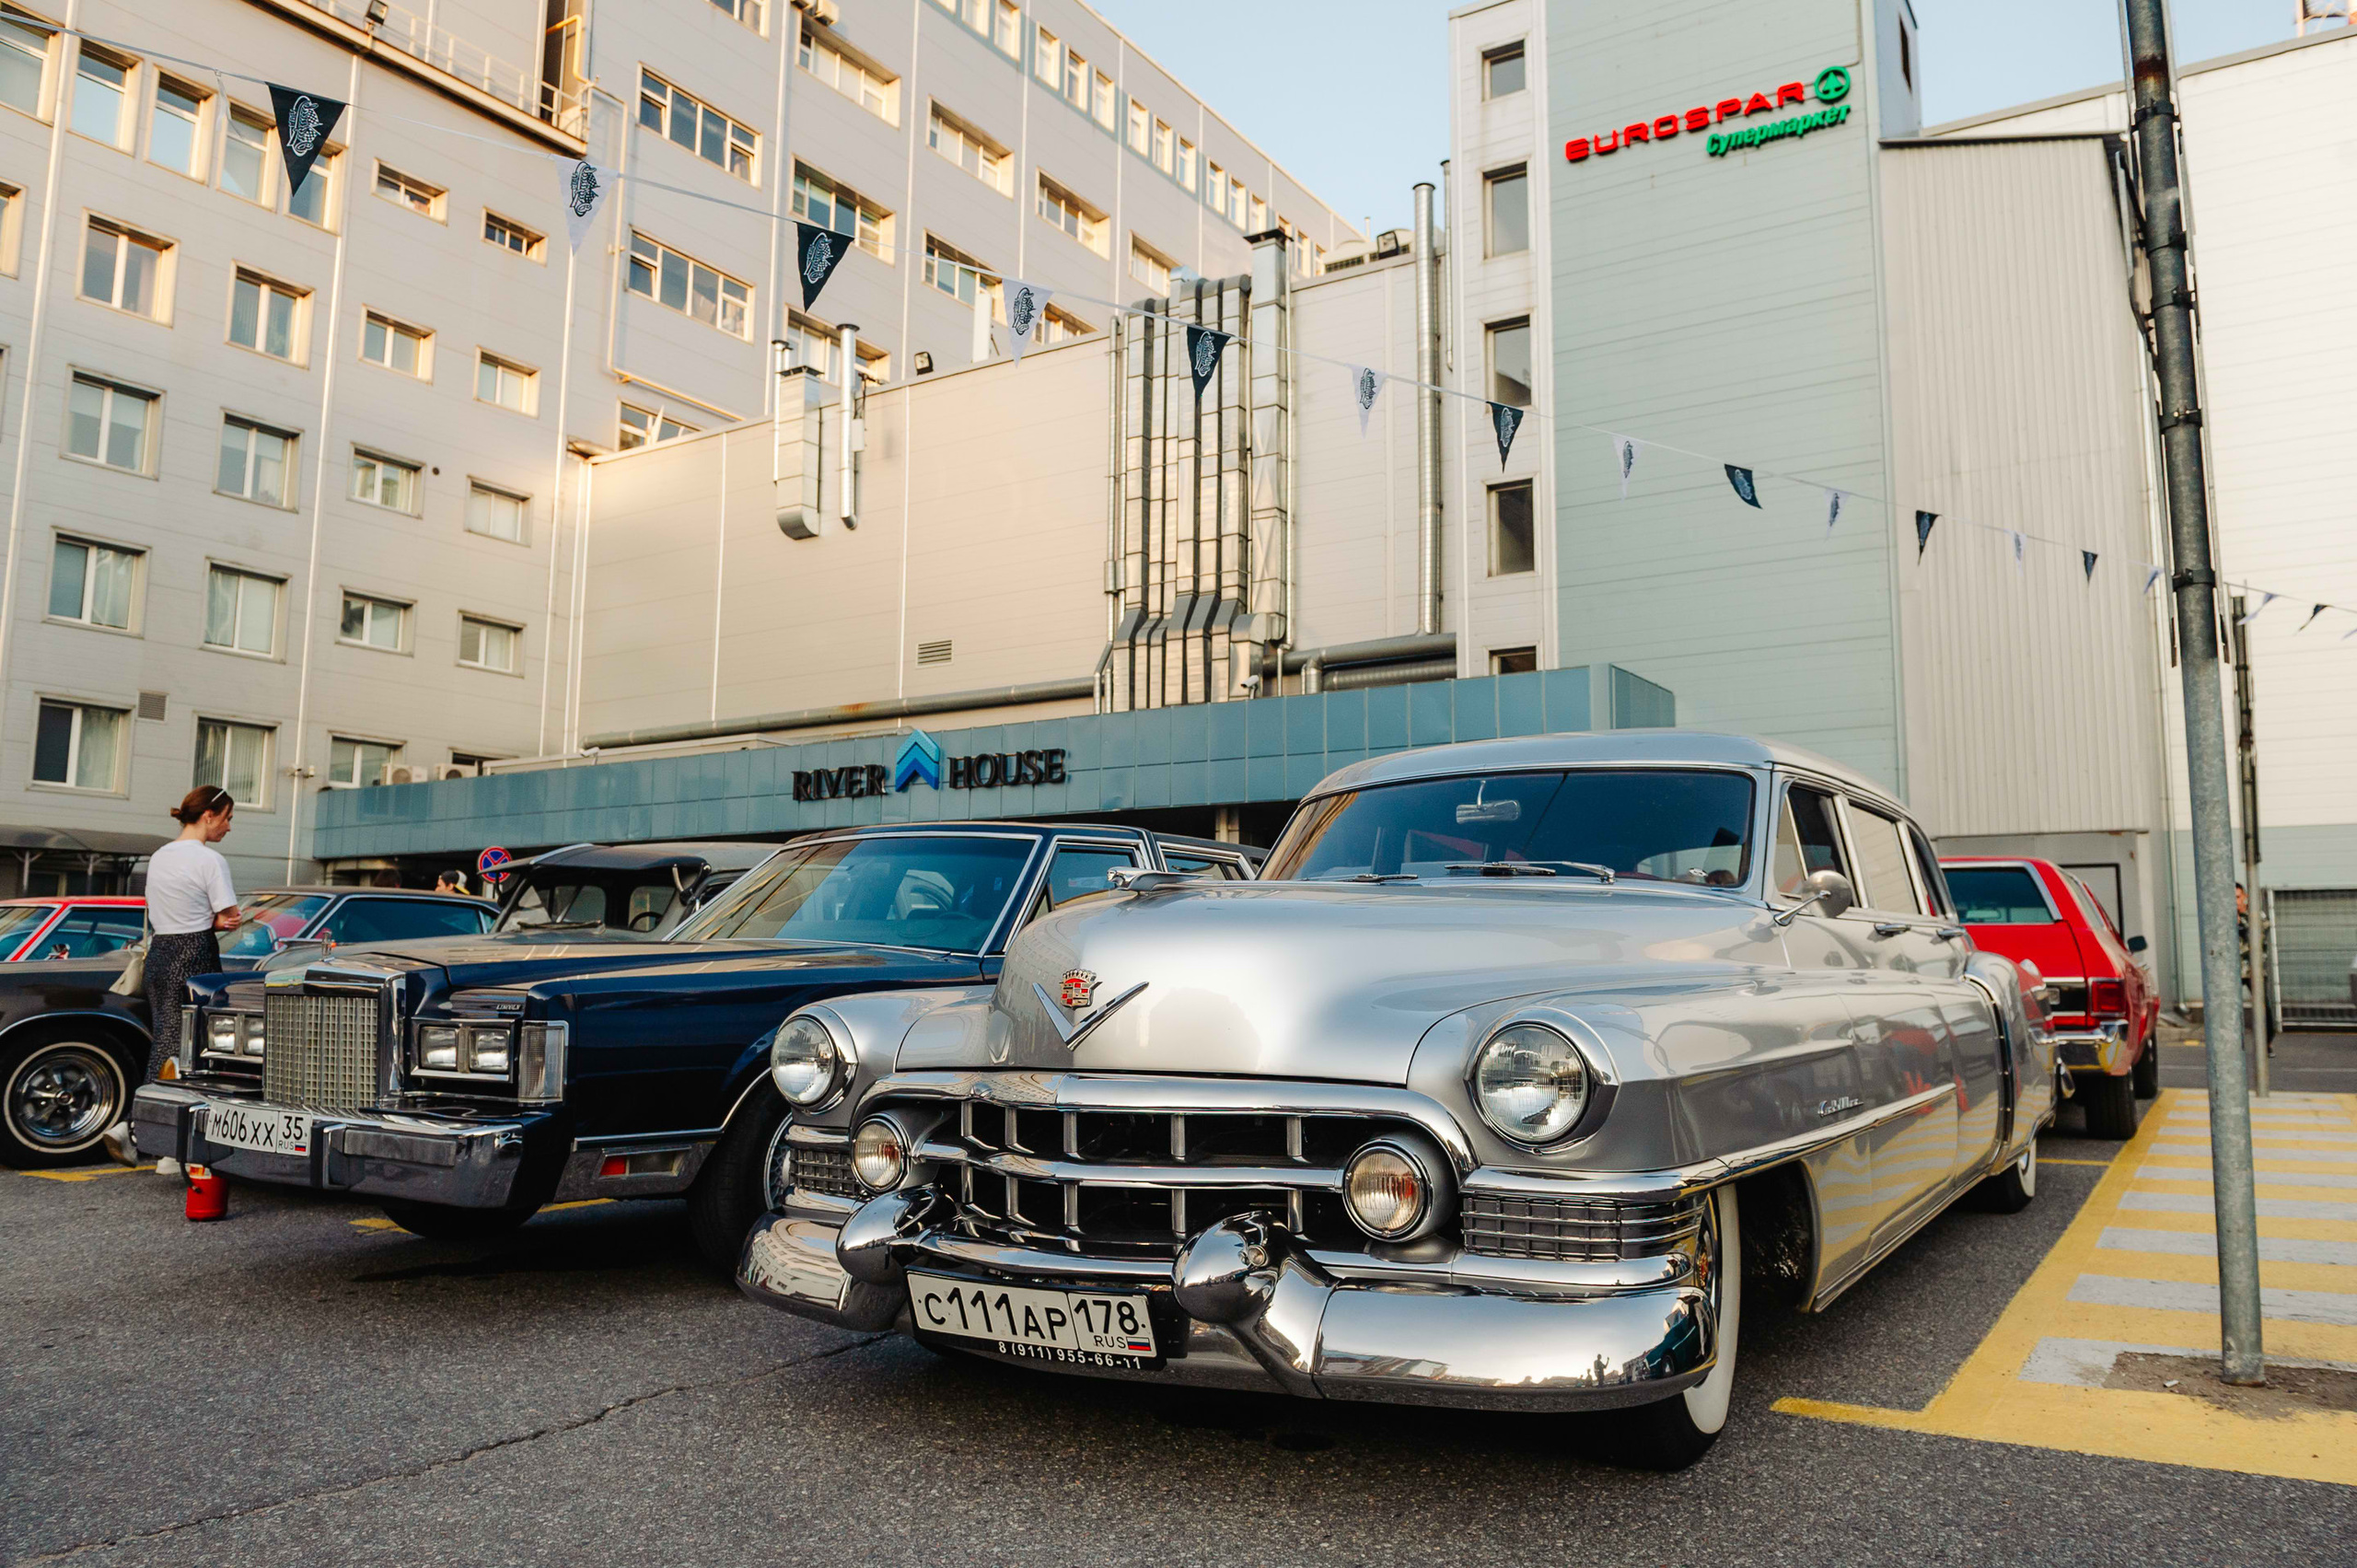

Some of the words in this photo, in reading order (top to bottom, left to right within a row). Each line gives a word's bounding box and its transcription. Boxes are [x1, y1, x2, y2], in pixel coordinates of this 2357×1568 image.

[1565, 81, 1805, 161] EUROSPAR
[1706, 104, 1851, 157] Супермаркет
[792, 764, 888, 801] RIVER
[946, 748, 1066, 789] HOUSE
[282, 1115, 304, 1140] 35
[278, 1140, 295, 1151] RUS
[1074, 1298, 1140, 1335] 178
[998, 1342, 1007, 1353] 8
[1011, 1342, 1051, 1361] (911)
[1093, 1334, 1126, 1349] RUS
